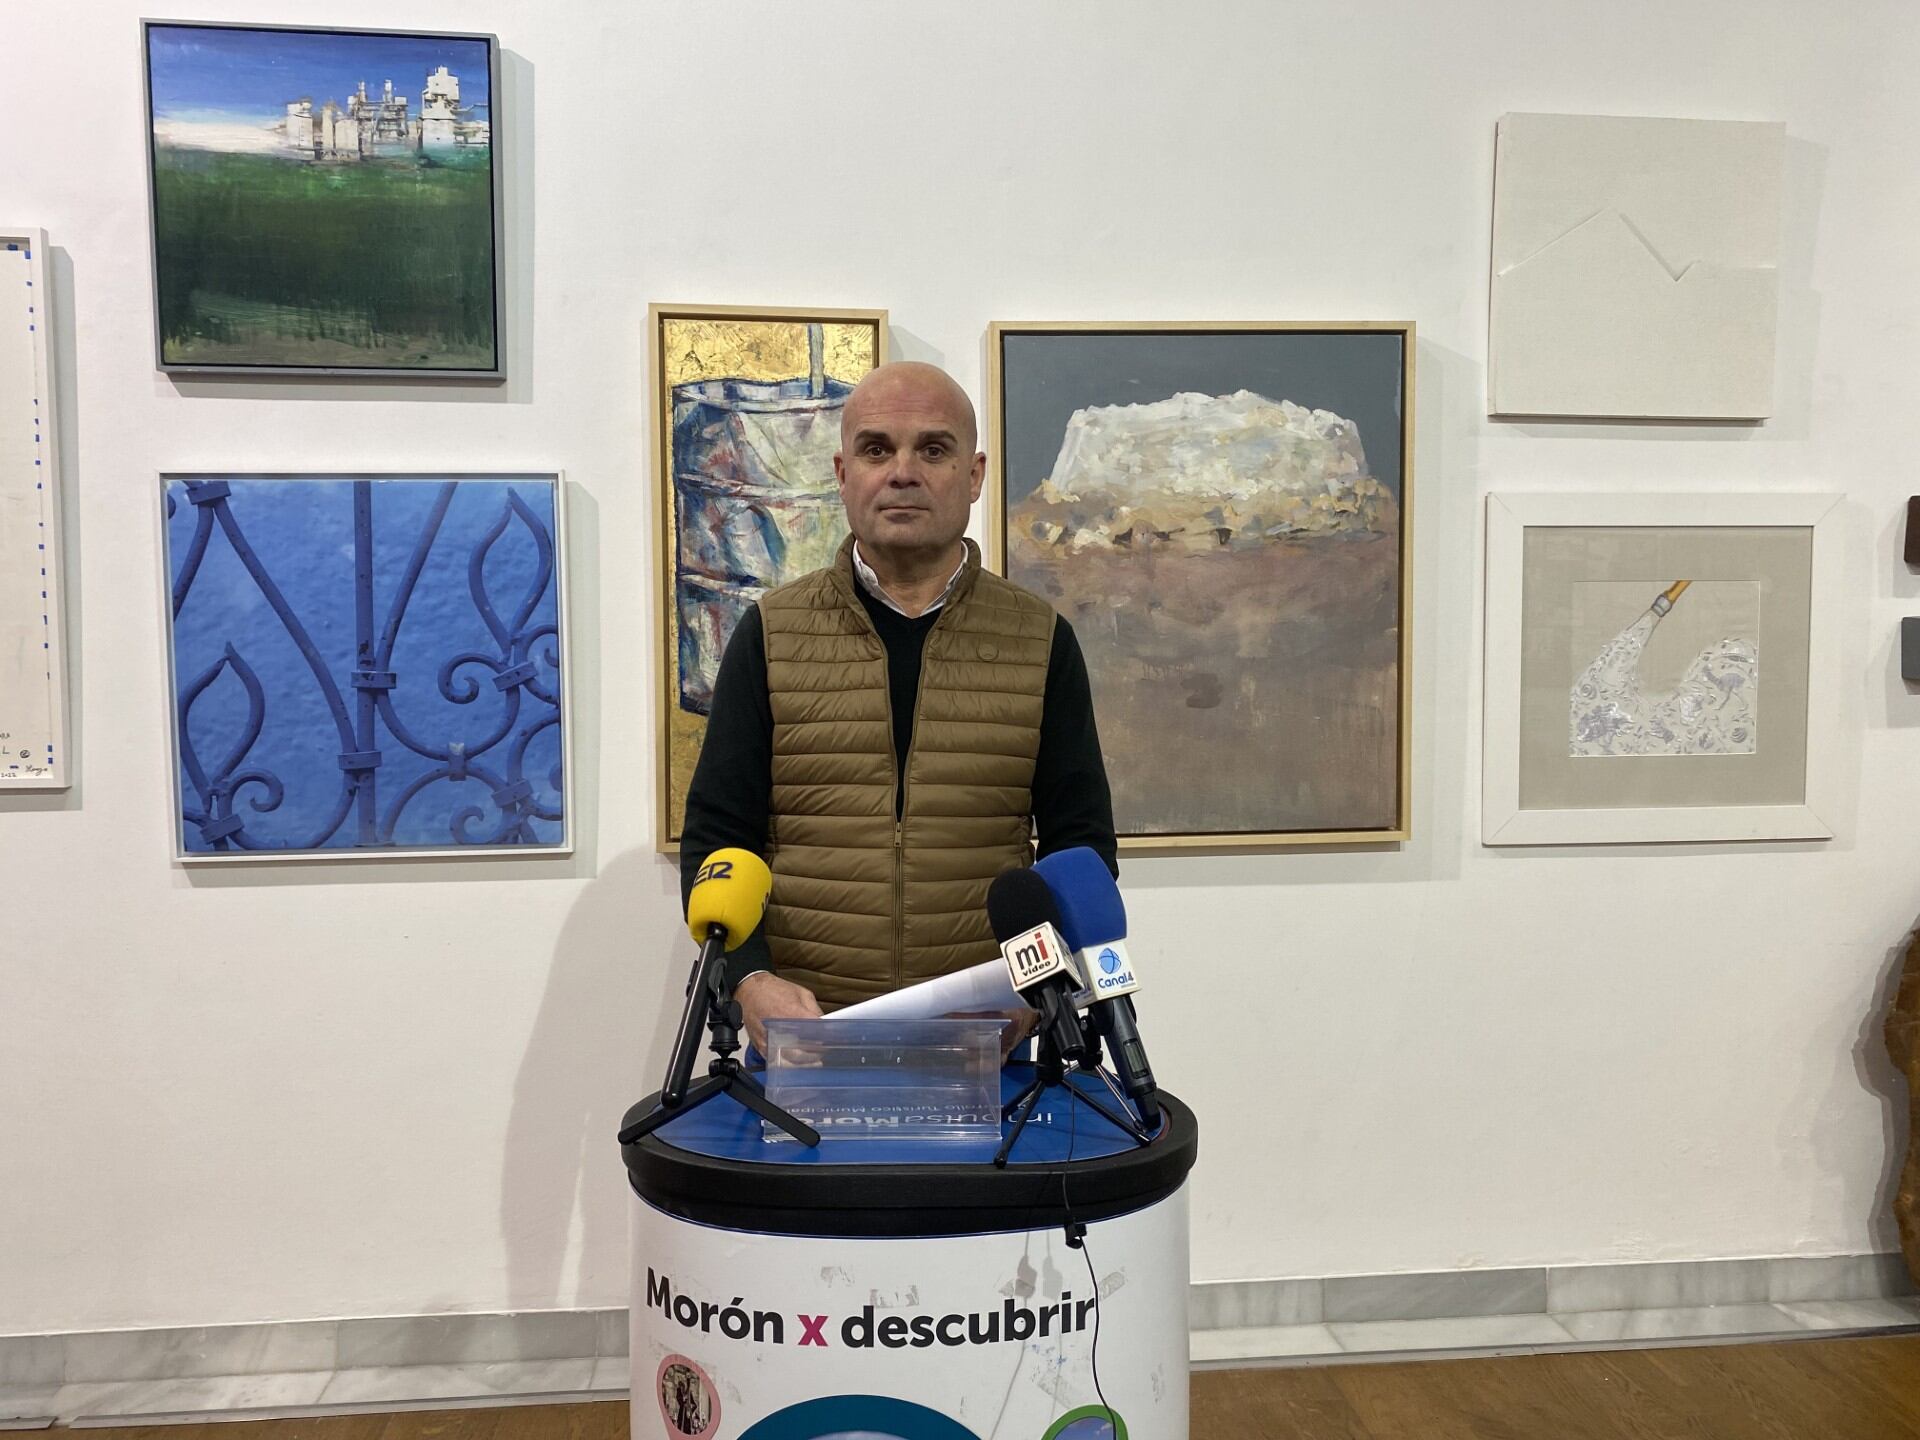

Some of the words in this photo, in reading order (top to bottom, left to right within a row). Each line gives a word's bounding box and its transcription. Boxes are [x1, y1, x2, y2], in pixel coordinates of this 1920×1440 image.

[694, 861, 733, 888] ER
[1015, 932, 1049, 970] mi
[1022, 961, 1051, 977] video
[647, 1266, 784, 1344] Morón
[797, 1314, 829, 1347] x
[841, 1291, 1095, 1349] descubrir
